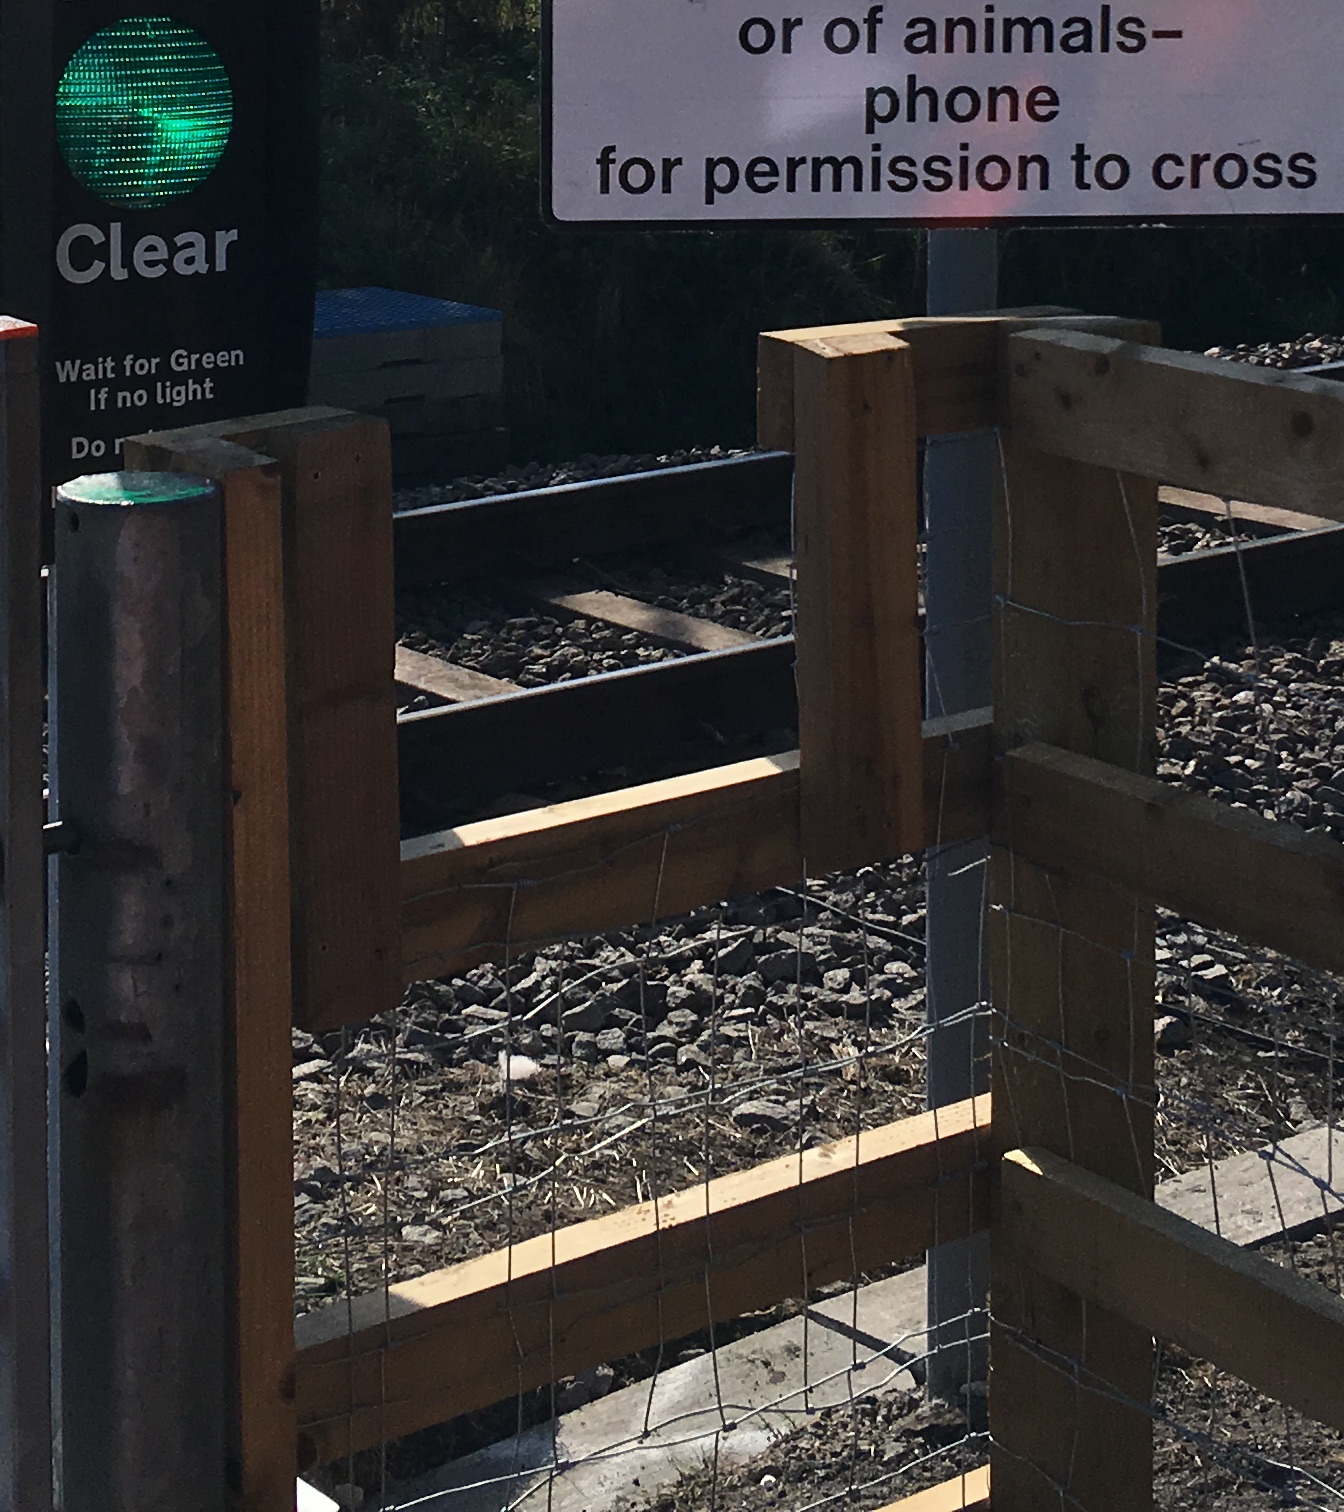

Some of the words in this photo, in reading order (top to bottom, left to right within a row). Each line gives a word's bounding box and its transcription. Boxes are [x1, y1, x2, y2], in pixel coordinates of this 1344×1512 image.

[738, 16, 802, 55] or
[823, 4, 884, 55] of
[865, 74, 1061, 134] phone
[596, 146, 683, 196] for
[704, 144, 1050, 205] permission
[1072, 144, 1130, 191] to
[1151, 147, 1318, 191] cross
[56, 222, 238, 284] Clear
[56, 357, 115, 382] Wait
[124, 354, 160, 376] for
[170, 348, 244, 372] Green
[89, 389, 108, 410] If
[117, 390, 147, 408] no
[156, 378, 214, 407] light
[71, 437, 105, 459] Do
